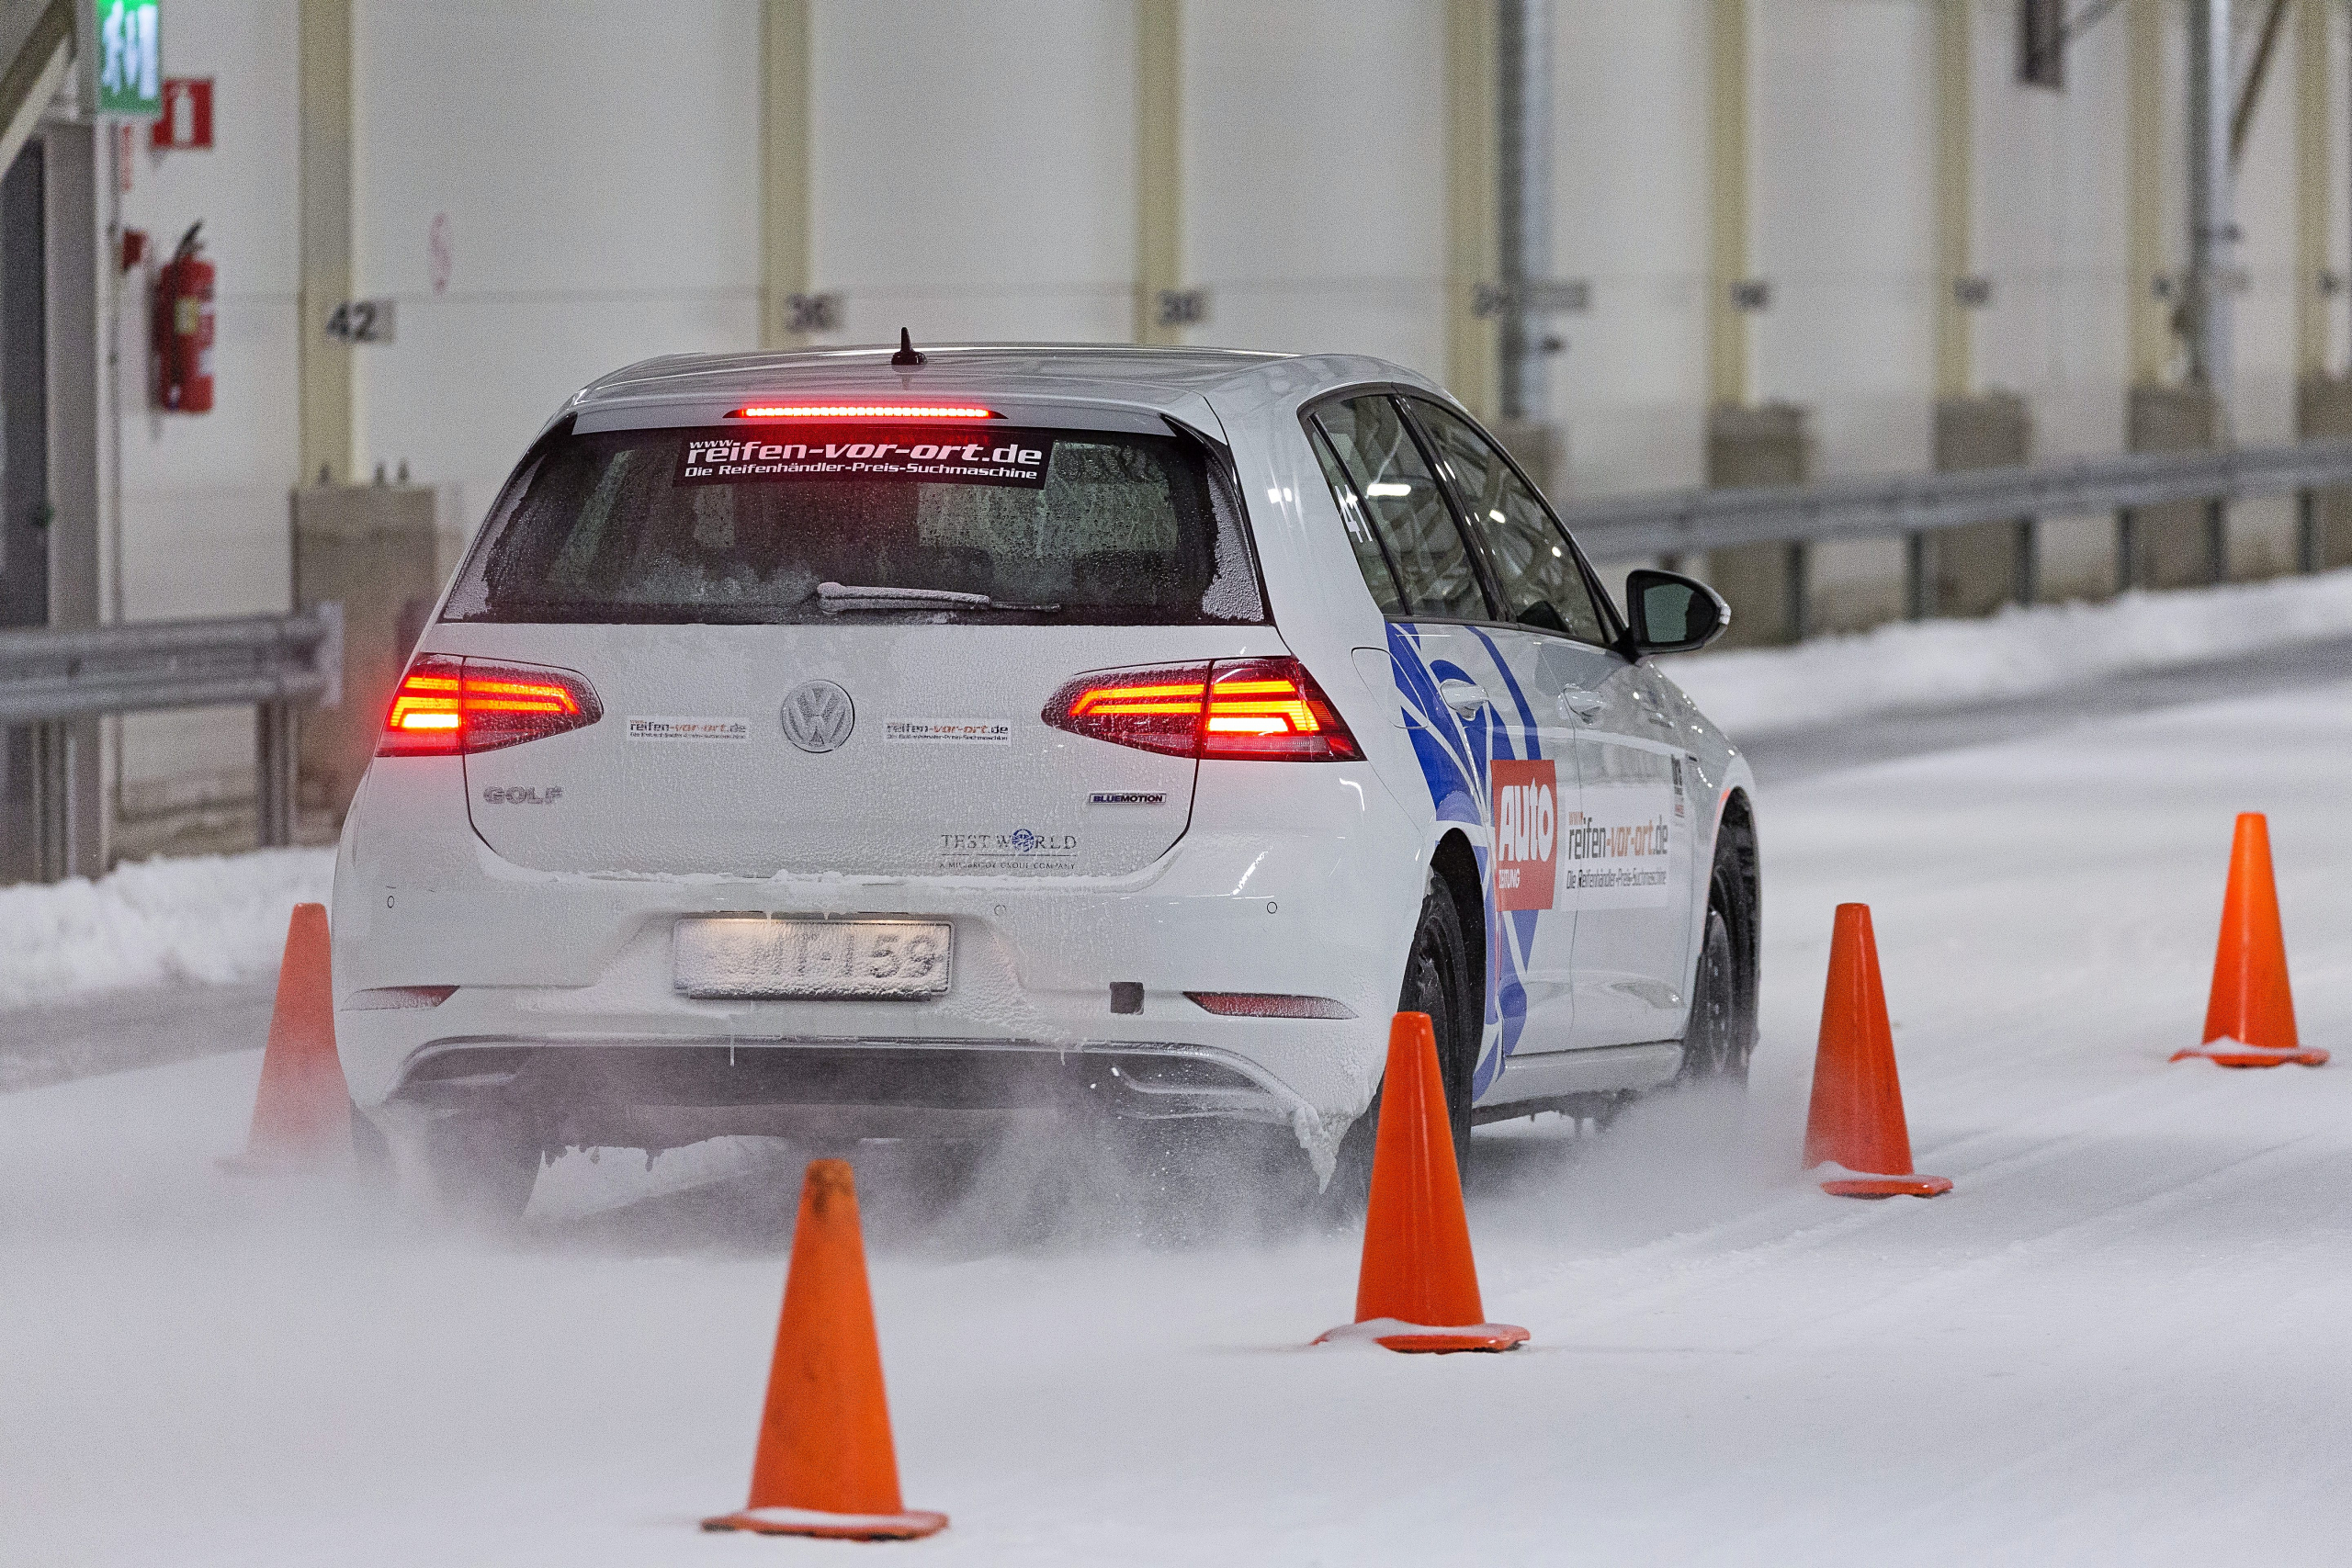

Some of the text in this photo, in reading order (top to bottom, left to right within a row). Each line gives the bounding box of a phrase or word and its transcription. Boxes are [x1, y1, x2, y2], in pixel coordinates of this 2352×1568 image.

[327, 300, 378, 342] 42
[687, 441, 1042, 466] reifen-vor-ort.de
[684, 462, 1037, 479] Die Reifenhändler-Preis-Suchmaschine
[483, 785, 563, 805] GOLF
[1093, 795, 1163, 803] BLUEMOTION
[942, 834, 991, 850] TEST
[1568, 814, 1668, 860] reifen-vor-ort.de
